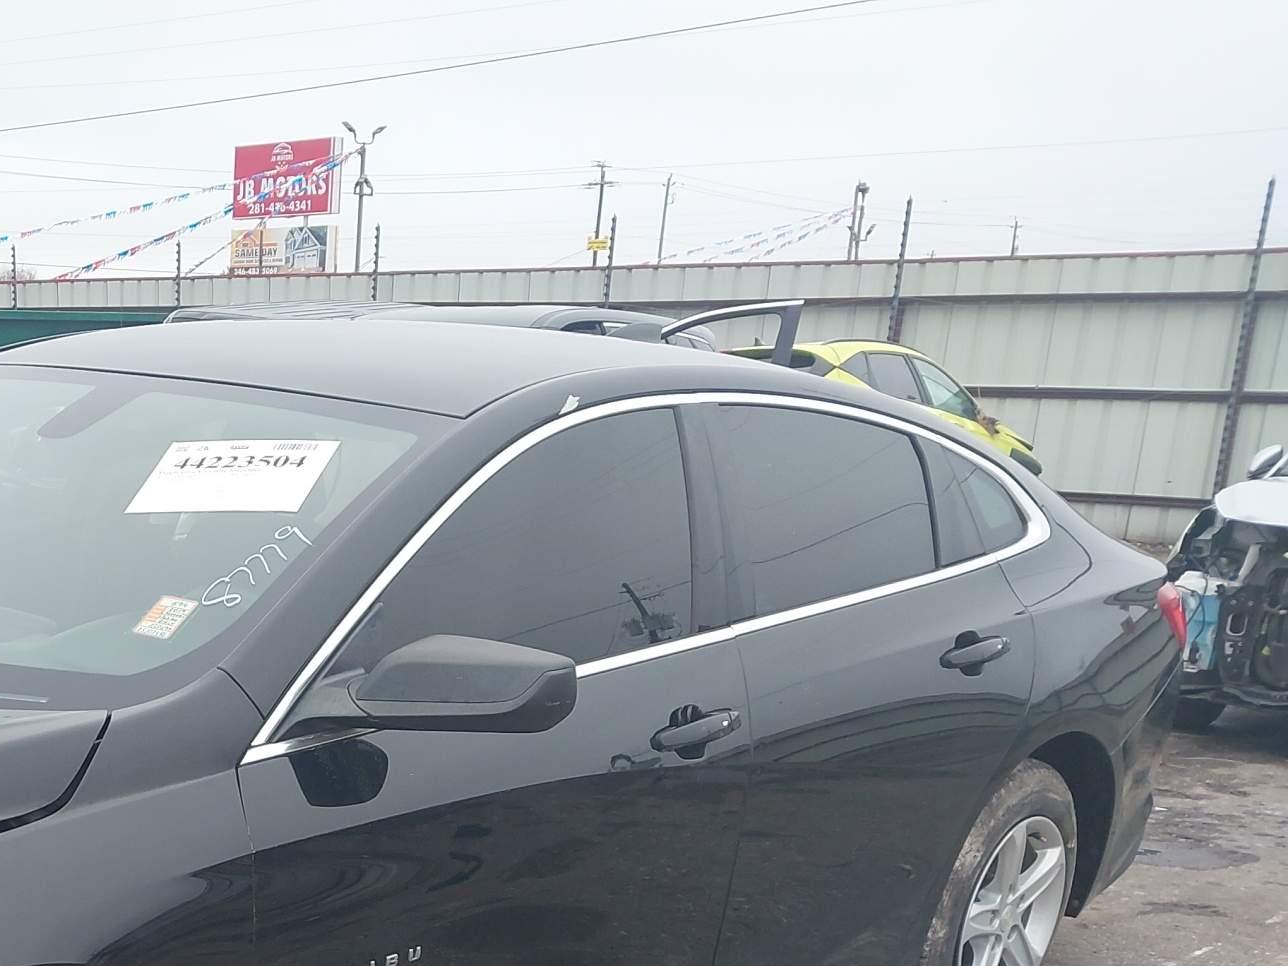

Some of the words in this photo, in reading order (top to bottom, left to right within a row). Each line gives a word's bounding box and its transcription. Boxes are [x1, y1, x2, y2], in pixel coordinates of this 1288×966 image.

[236, 178, 255, 201] JB
[261, 174, 327, 199] MOTORS
[234, 248, 259, 258] SAME
[262, 247, 278, 257] DAY
[173, 455, 308, 469] 44223504
